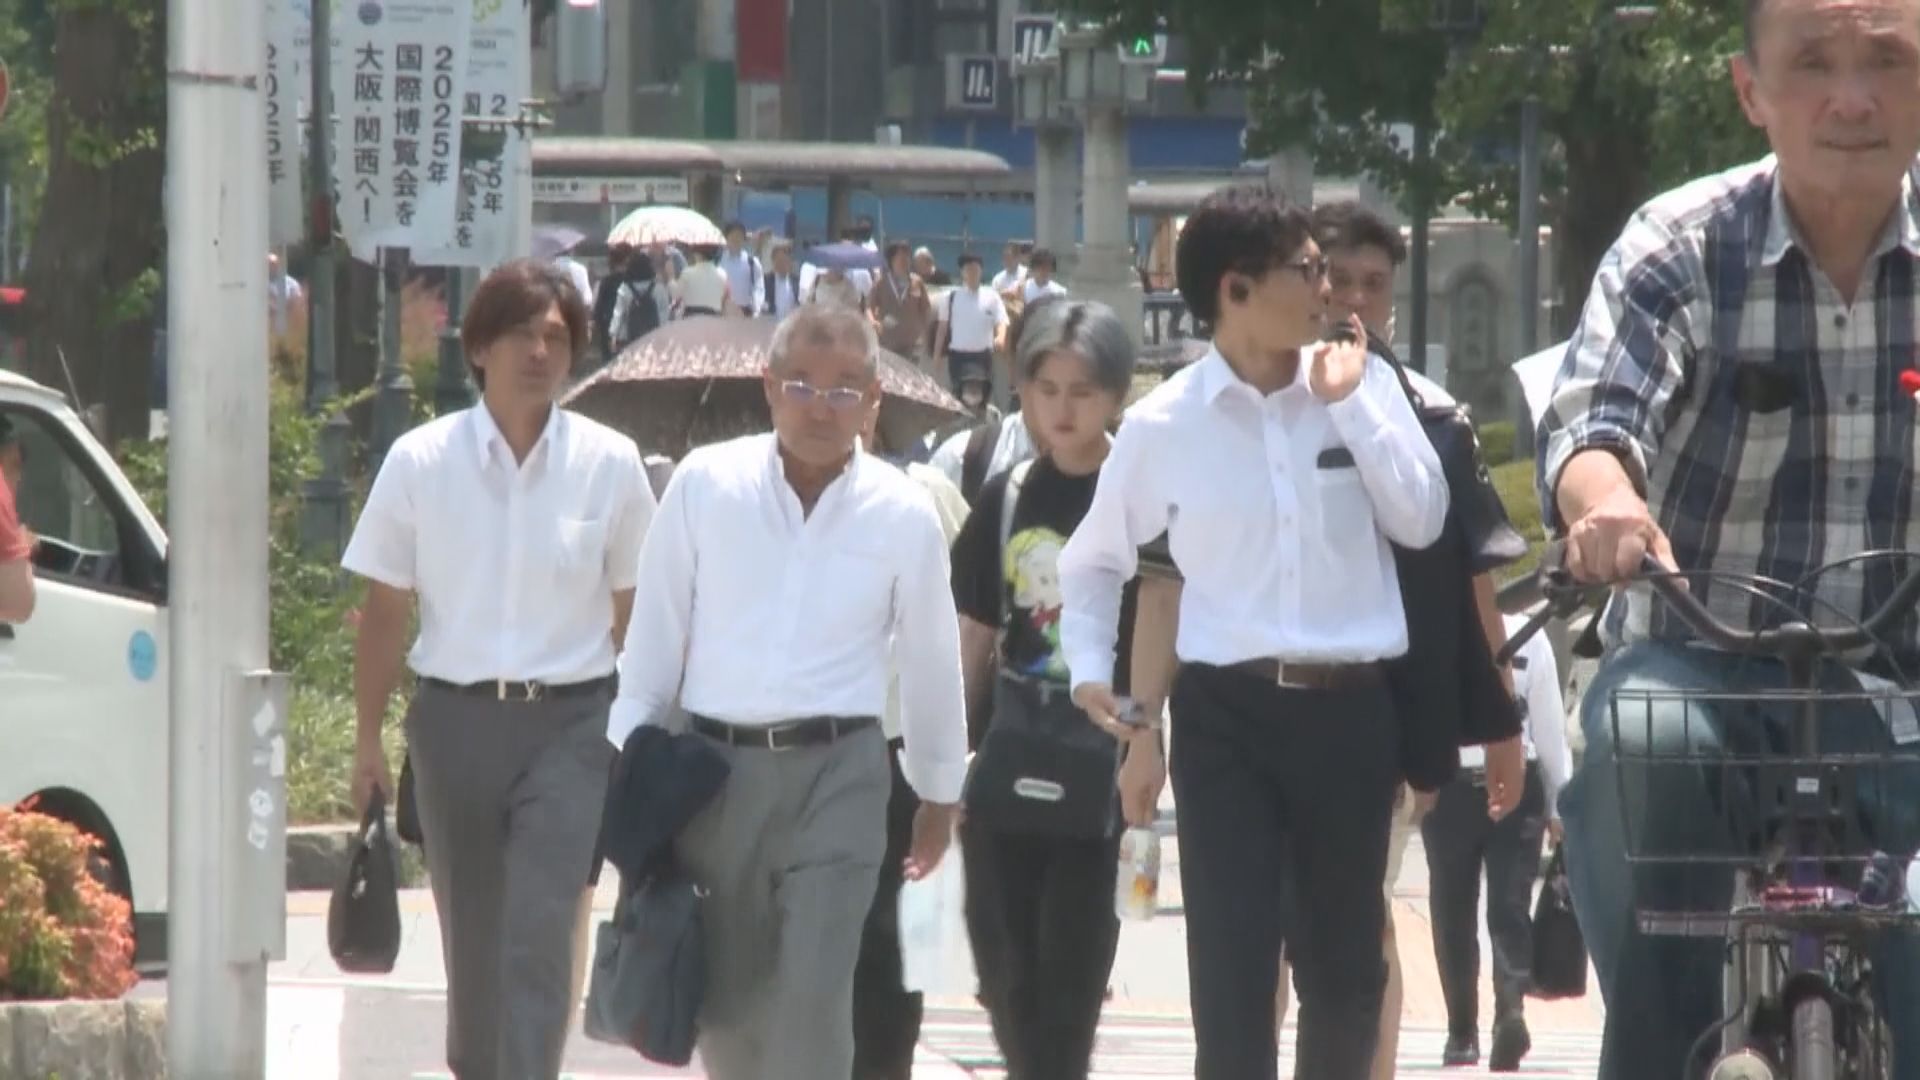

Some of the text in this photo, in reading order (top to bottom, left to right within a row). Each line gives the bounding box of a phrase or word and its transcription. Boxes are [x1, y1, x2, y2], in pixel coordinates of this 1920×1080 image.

[393, 44, 422, 227] 国際博覧会を
[427, 46, 454, 186] 2025年
